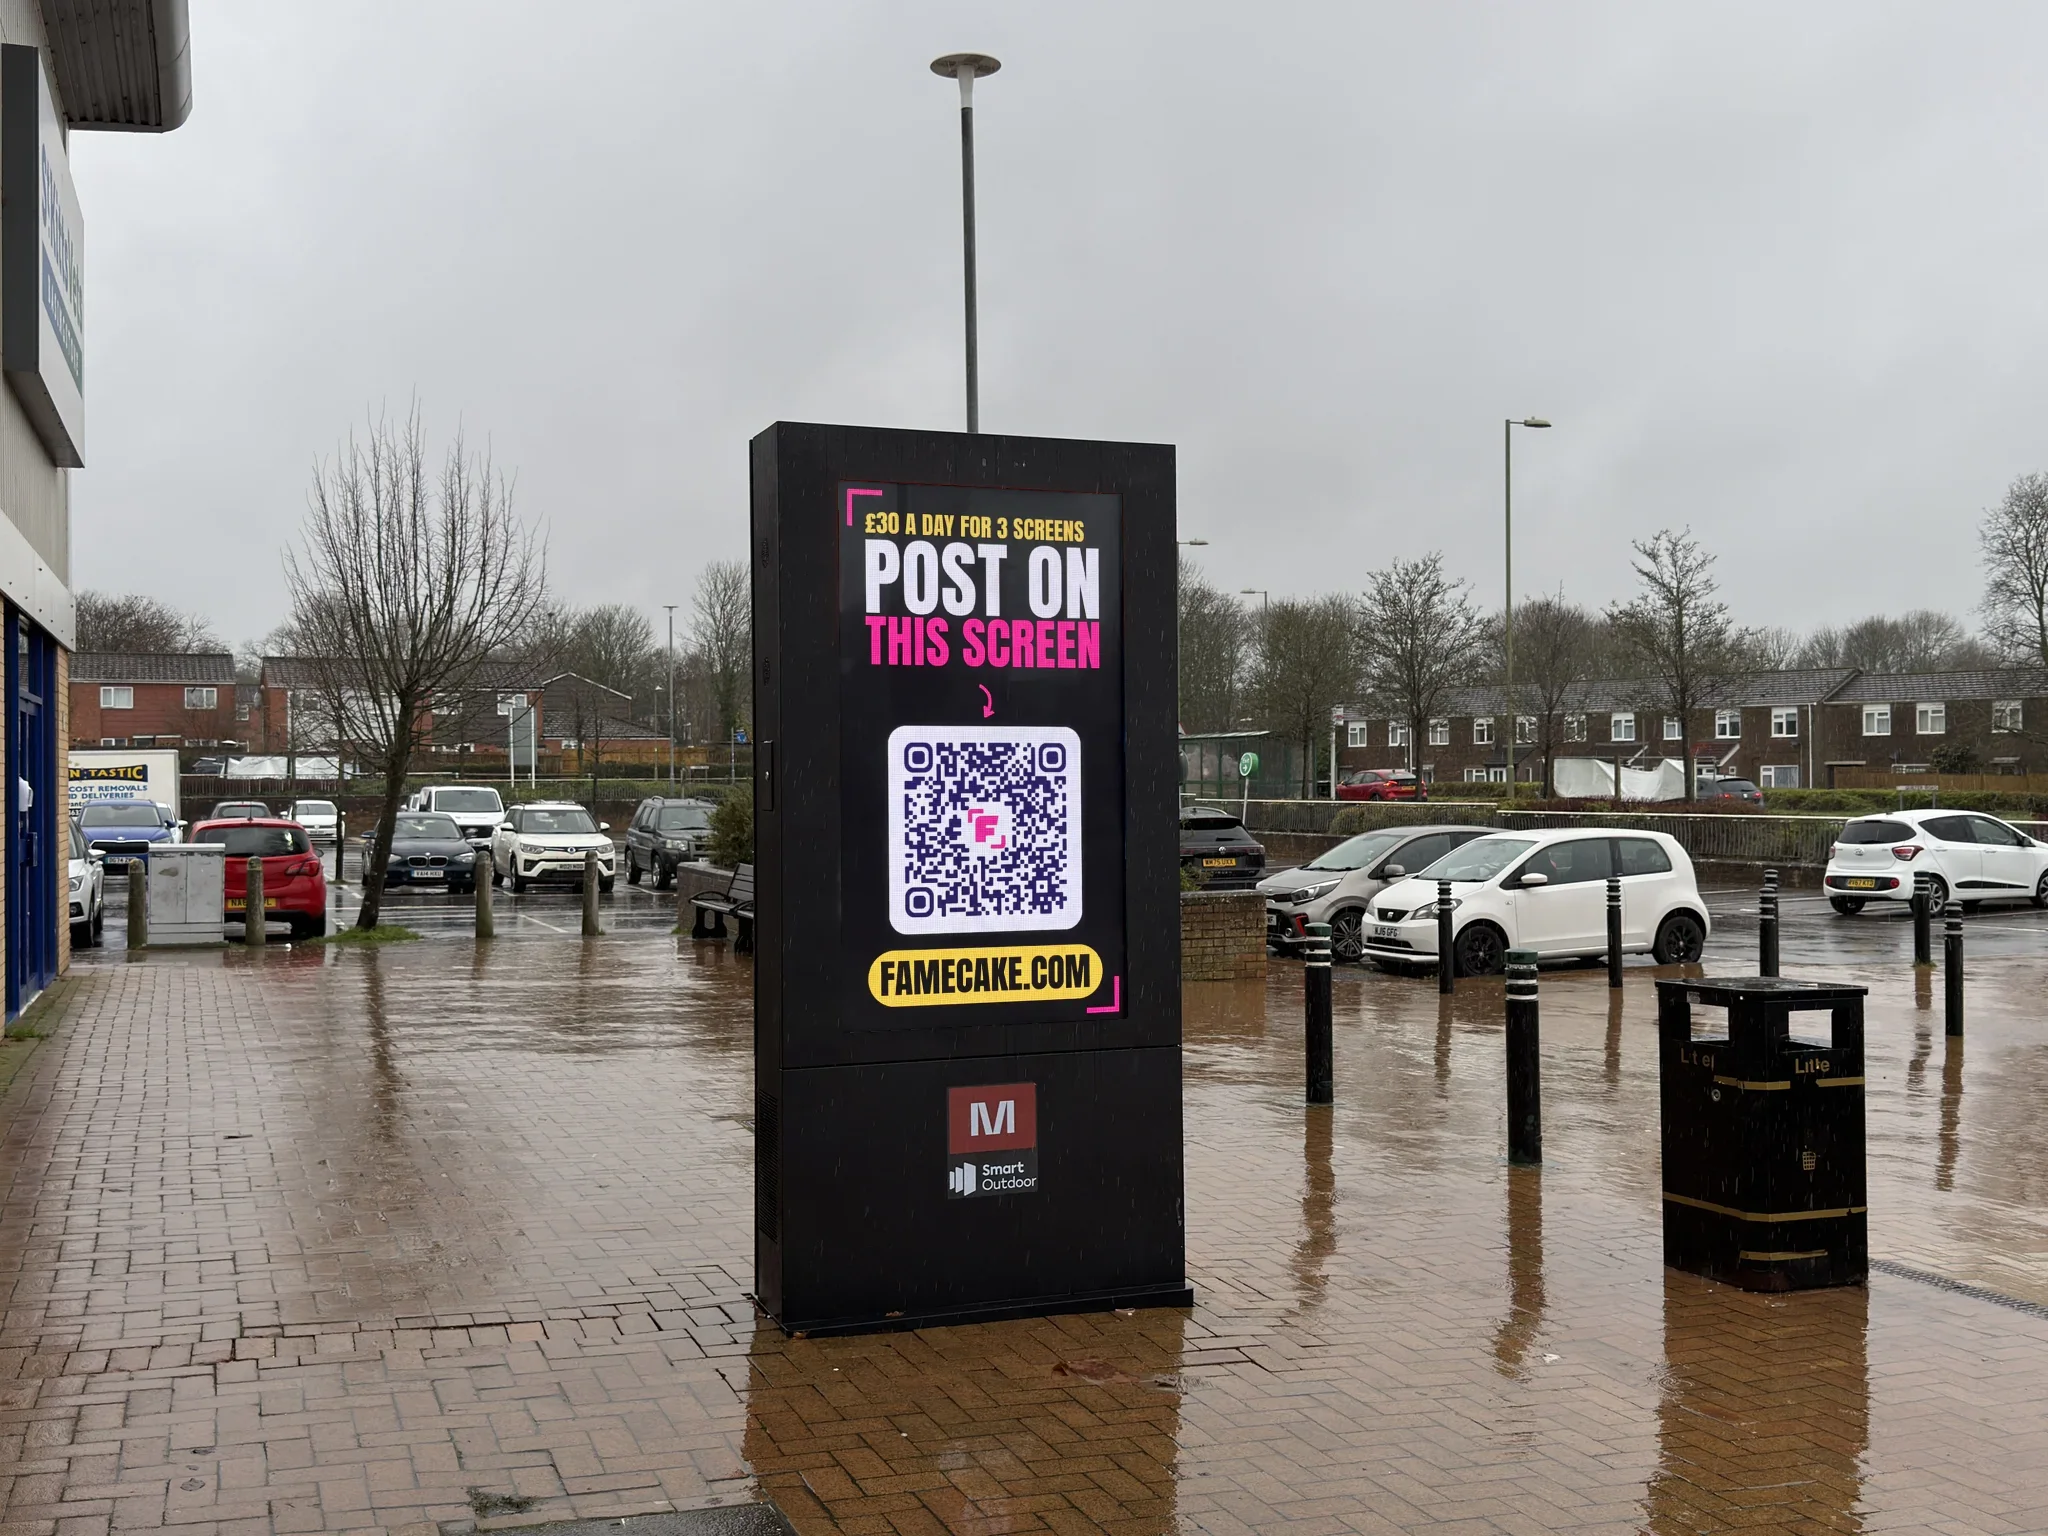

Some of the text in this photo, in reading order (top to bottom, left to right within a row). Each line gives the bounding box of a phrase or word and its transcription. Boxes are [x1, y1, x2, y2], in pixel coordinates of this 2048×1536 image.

[865, 512, 1085, 542] £30 A DAY FOR 3 SCREENS
[865, 538, 1100, 620] POST ON
[865, 615, 1100, 669] THIS SCREEN
[881, 954, 1090, 996] FAMECAKE.COM
[971, 1100, 1015, 1136] M
[982, 1161, 1025, 1176] Smart
[982, 1176, 1037, 1191] Outdoor
